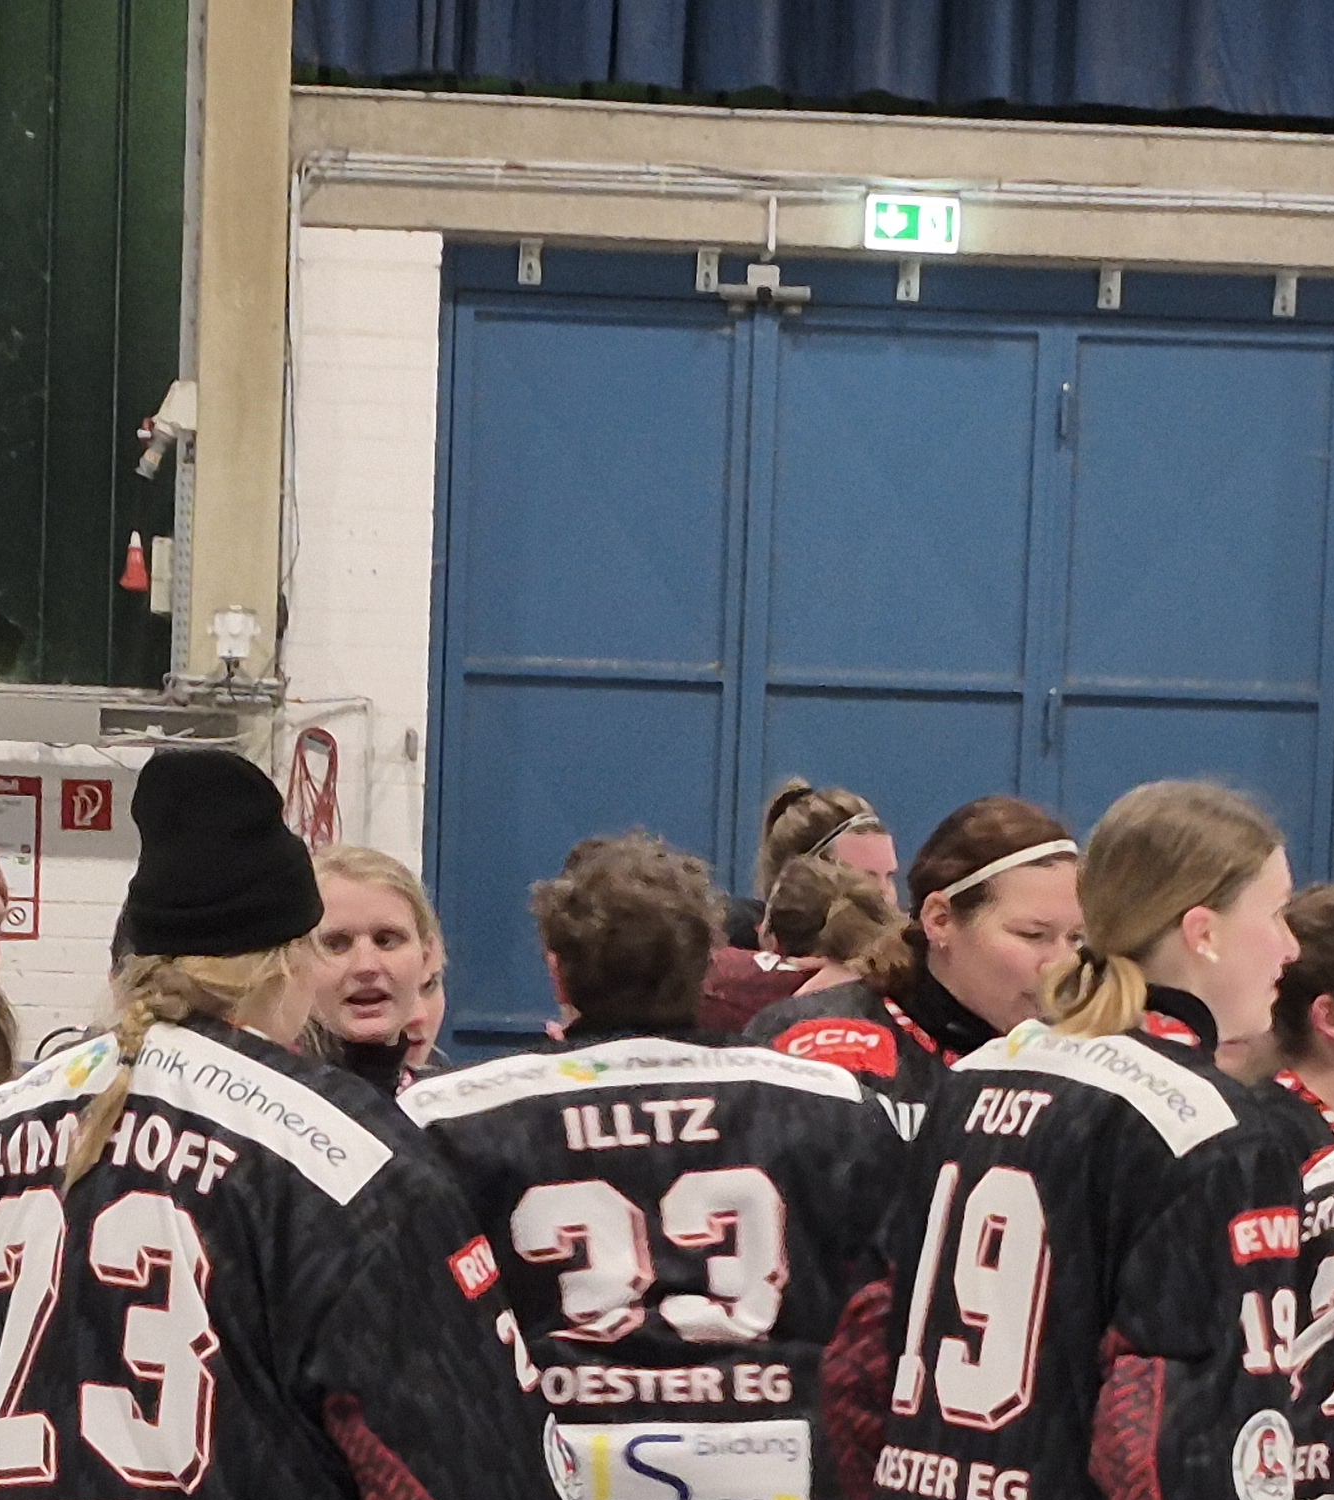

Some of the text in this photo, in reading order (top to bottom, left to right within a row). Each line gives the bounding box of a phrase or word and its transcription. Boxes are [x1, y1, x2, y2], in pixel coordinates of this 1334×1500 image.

[787, 1029, 880, 1055] CCM
[130, 1040, 348, 1167] inik Möhnesee
[562, 1097, 720, 1150] ILLTZ
[964, 1086, 1053, 1138] FUST
[510, 1166, 792, 1344] 33
[891, 1161, 1053, 1430] 19
[540, 1363, 793, 1405] OESTER EG
